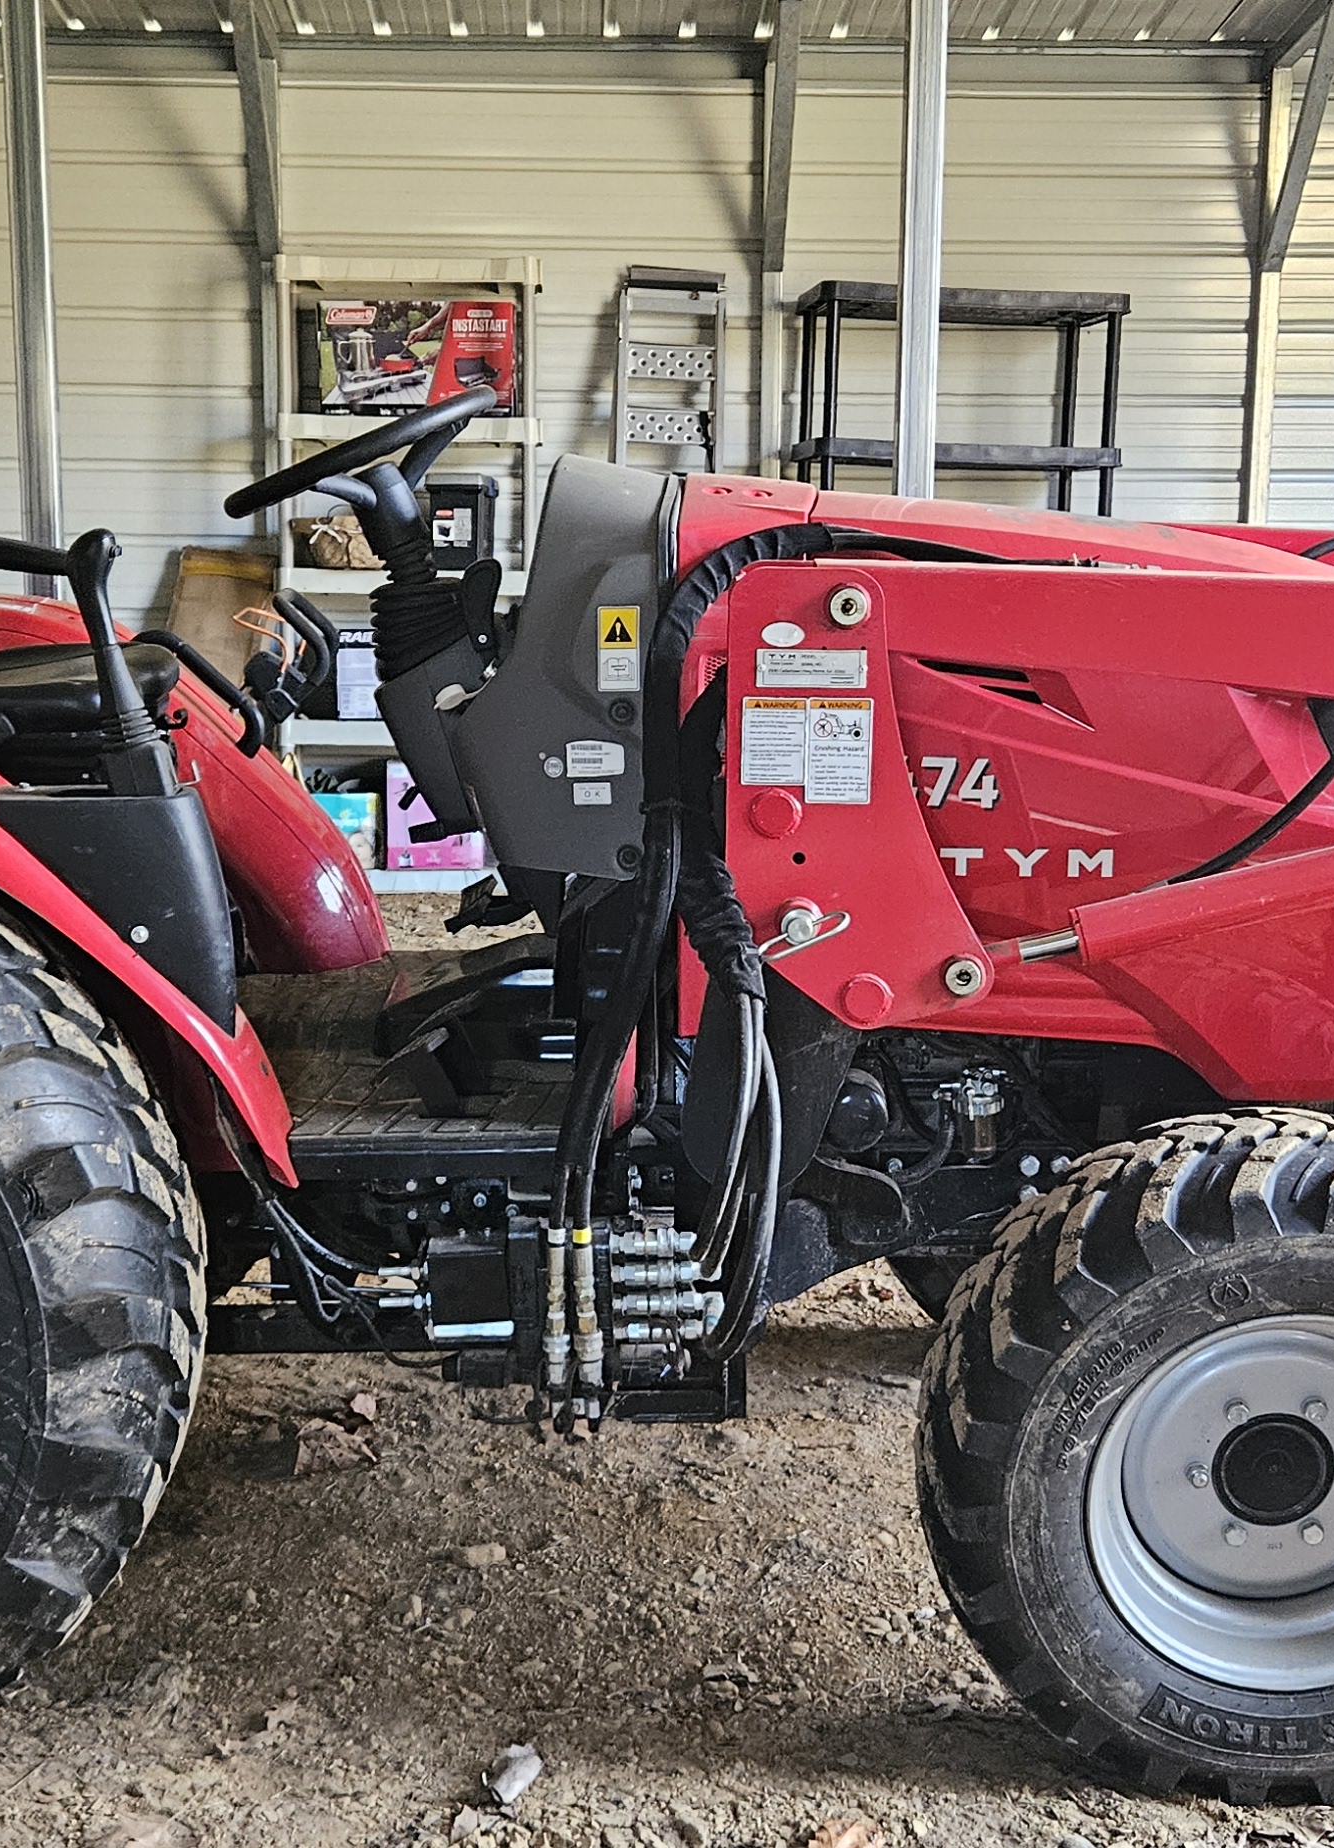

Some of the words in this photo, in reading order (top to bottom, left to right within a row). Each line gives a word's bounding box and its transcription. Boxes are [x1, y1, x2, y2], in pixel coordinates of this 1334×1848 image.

[330, 309, 365, 320] Coleman
[452, 318, 508, 332] INSTASTART
[762, 701, 798, 709] WARNING
[828, 701, 863, 709] WARNING
[904, 756, 999, 809] 74
[939, 847, 1114, 878] TYM
[1053, 1339, 1125, 1433] HYBRID
[1056, 1379, 1110, 1470] POWER
[1109, 1326, 1166, 1377] GRIP
[1161, 1697, 1308, 1749] TIRON
